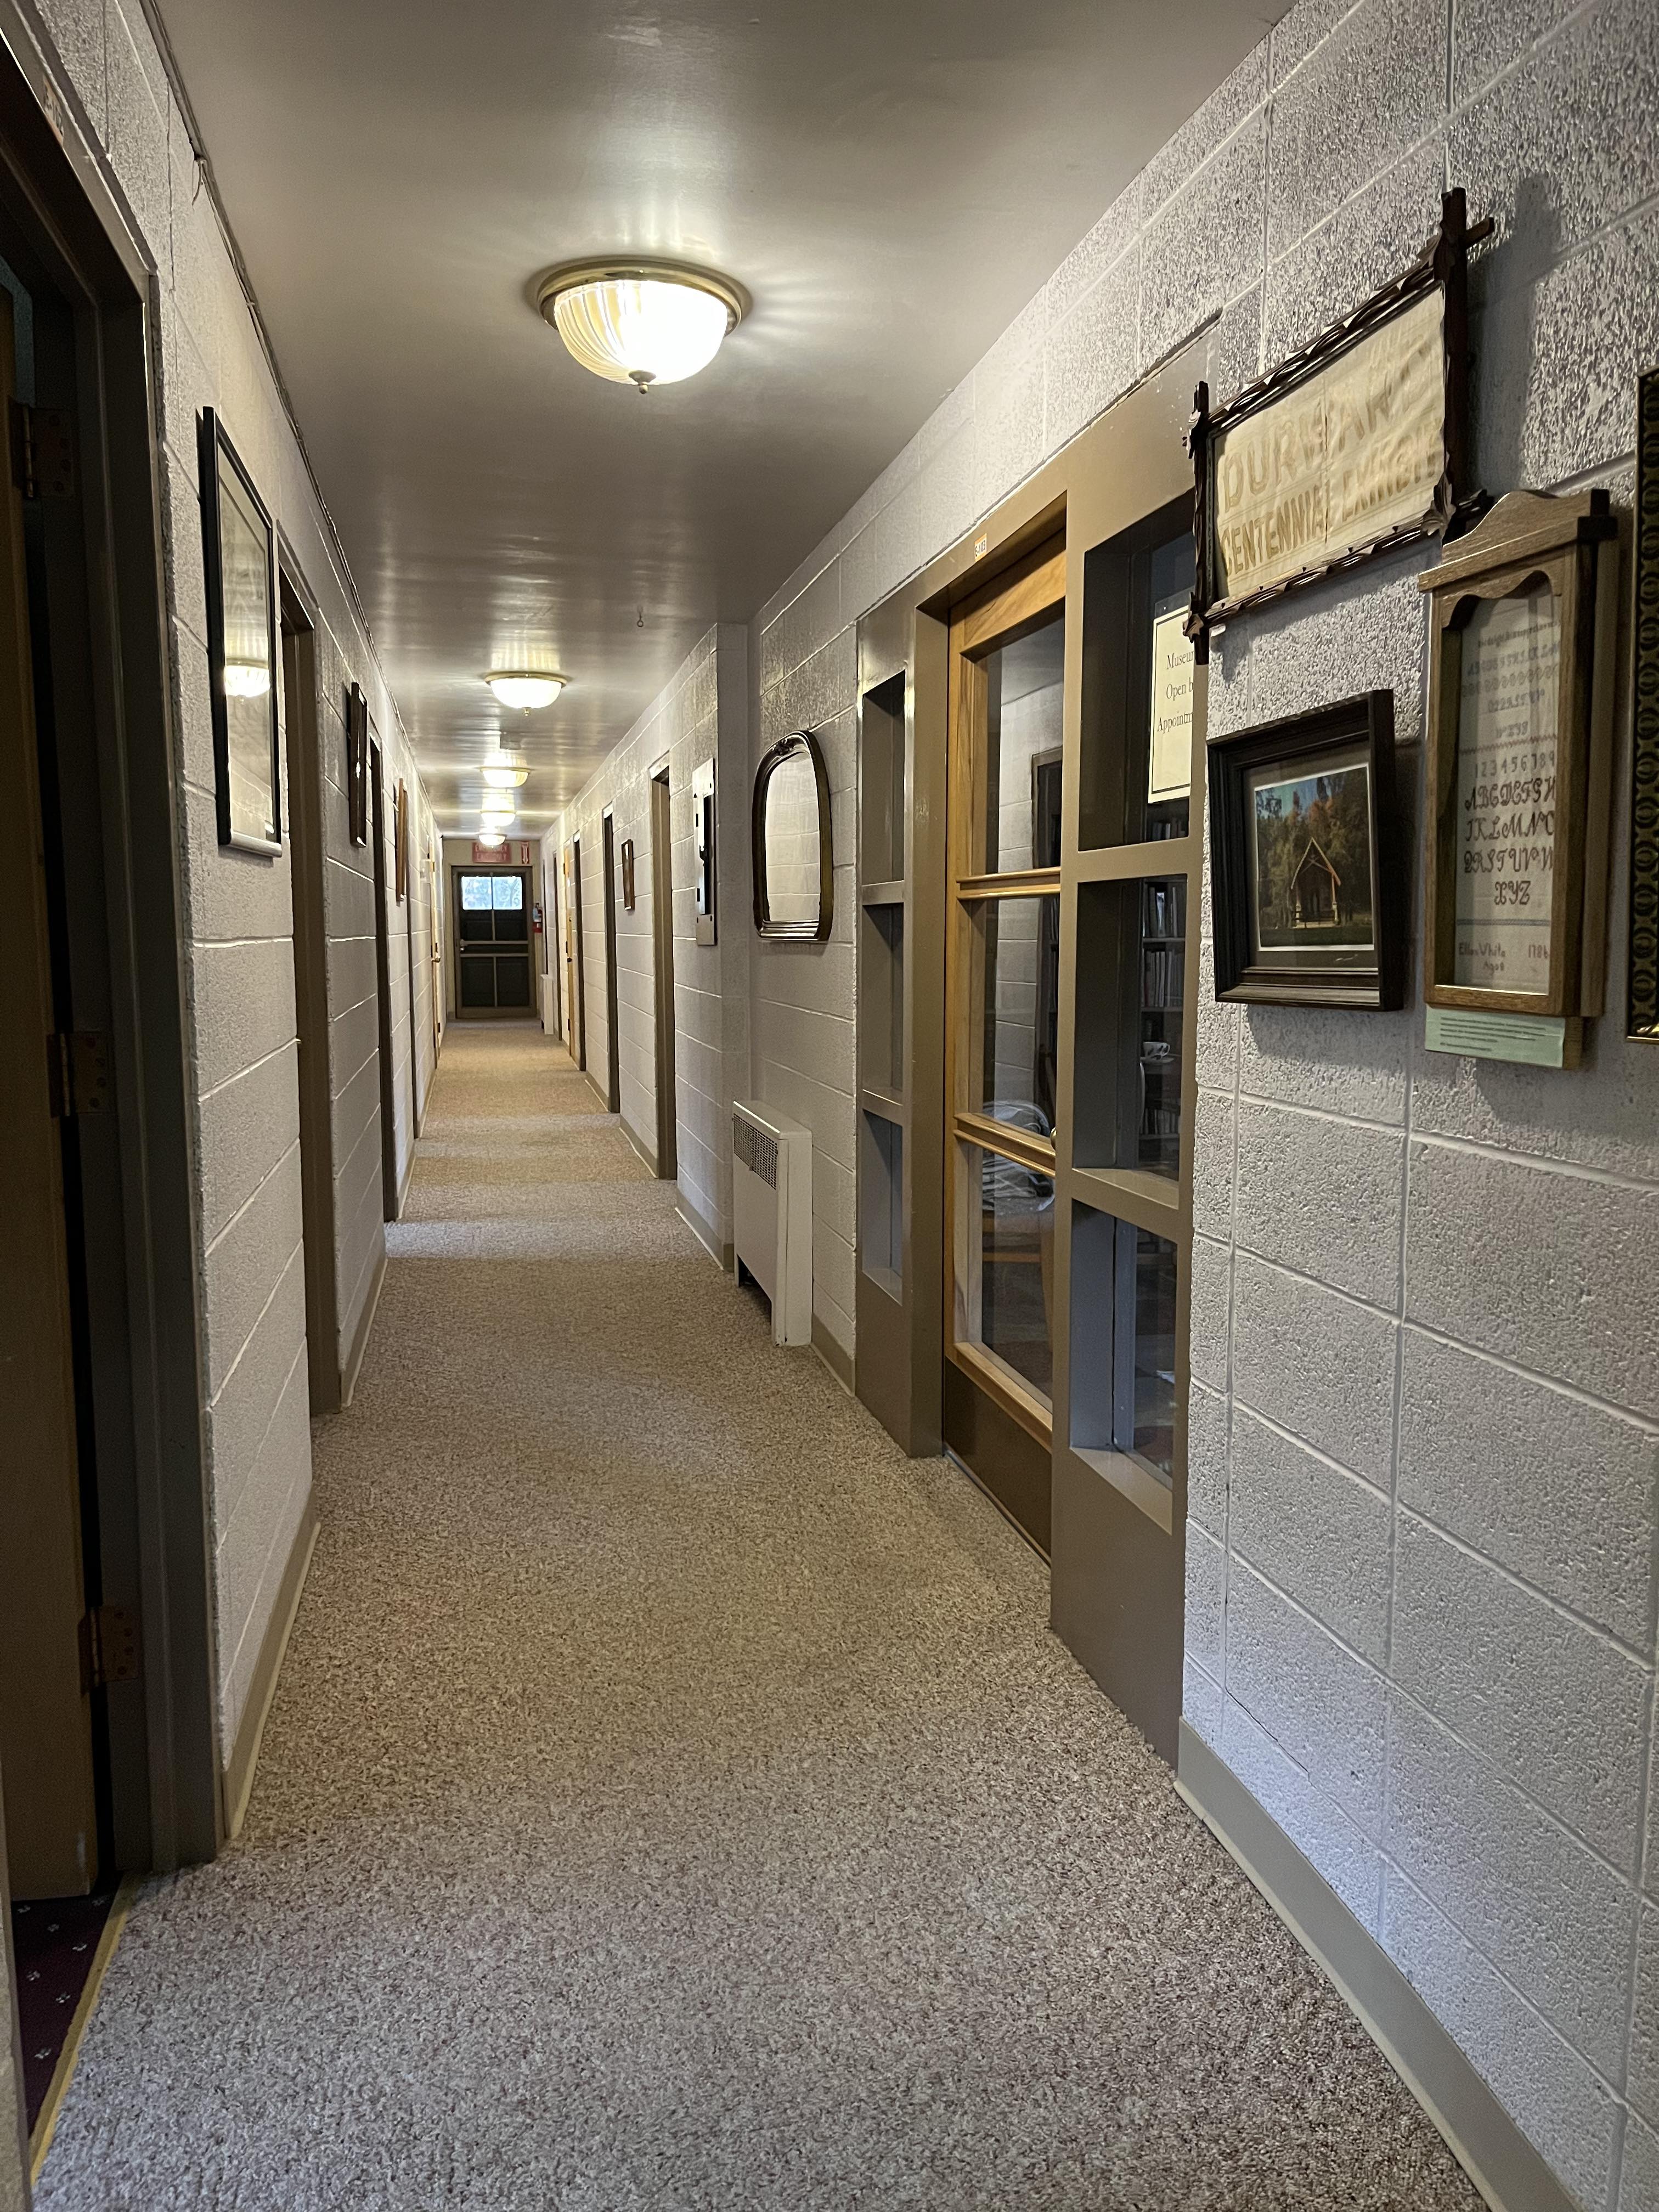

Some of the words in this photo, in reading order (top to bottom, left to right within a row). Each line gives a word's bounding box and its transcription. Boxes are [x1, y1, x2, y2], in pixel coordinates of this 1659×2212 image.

[975, 539, 985, 557] E-103
[1166, 684, 1186, 701] Open
[1494, 880, 1531, 905] XYZ
